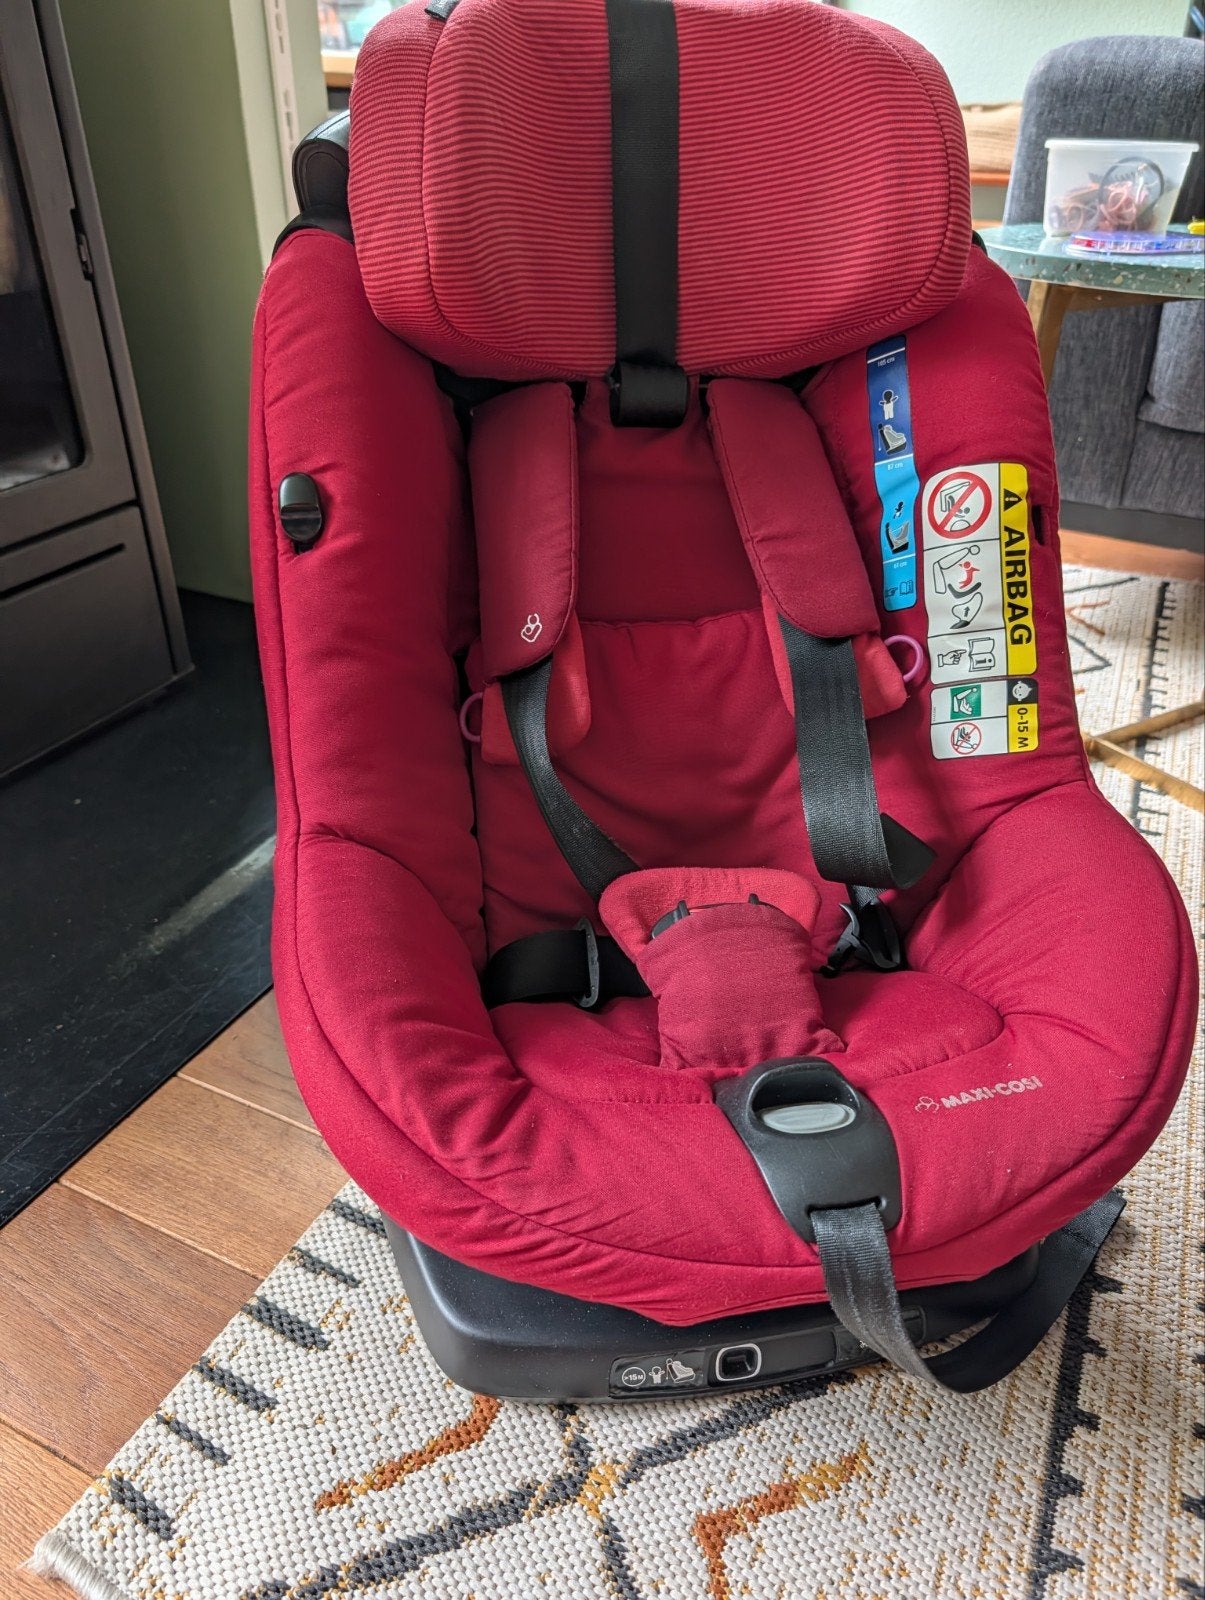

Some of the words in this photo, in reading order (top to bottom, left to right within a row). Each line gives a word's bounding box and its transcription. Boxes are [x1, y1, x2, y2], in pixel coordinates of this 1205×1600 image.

[1004, 525, 1032, 645] AIRBAG
[1017, 707, 1029, 733] 0-15
[1017, 736, 1029, 748] M
